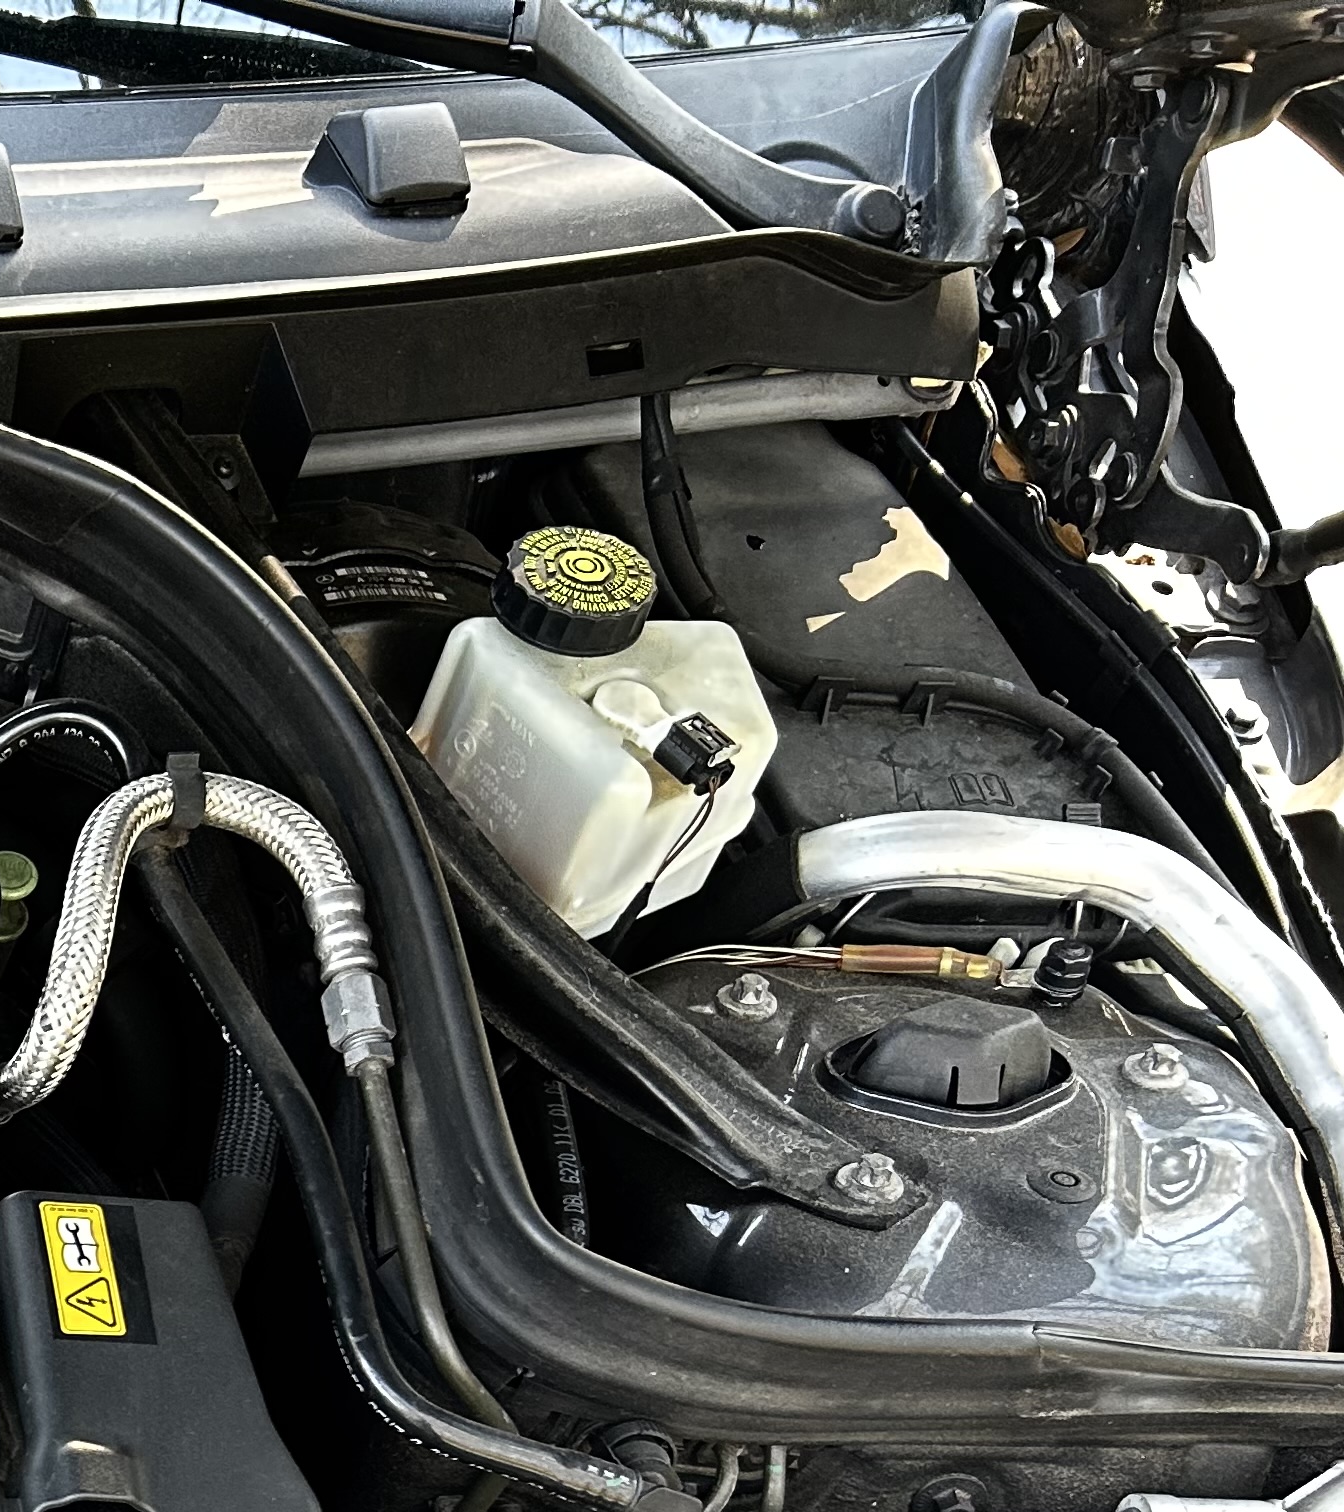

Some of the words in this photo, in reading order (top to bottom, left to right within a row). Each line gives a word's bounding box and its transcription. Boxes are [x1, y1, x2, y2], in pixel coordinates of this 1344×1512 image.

[564, 527, 600, 538] CLEAN
[526, 571, 546, 591] ONLY
[545, 589, 568, 605] USE
[546, 579, 609, 603] CONTAINER
[572, 599, 631, 613] REMOVING
[563, 1191, 584, 1214] DBL
